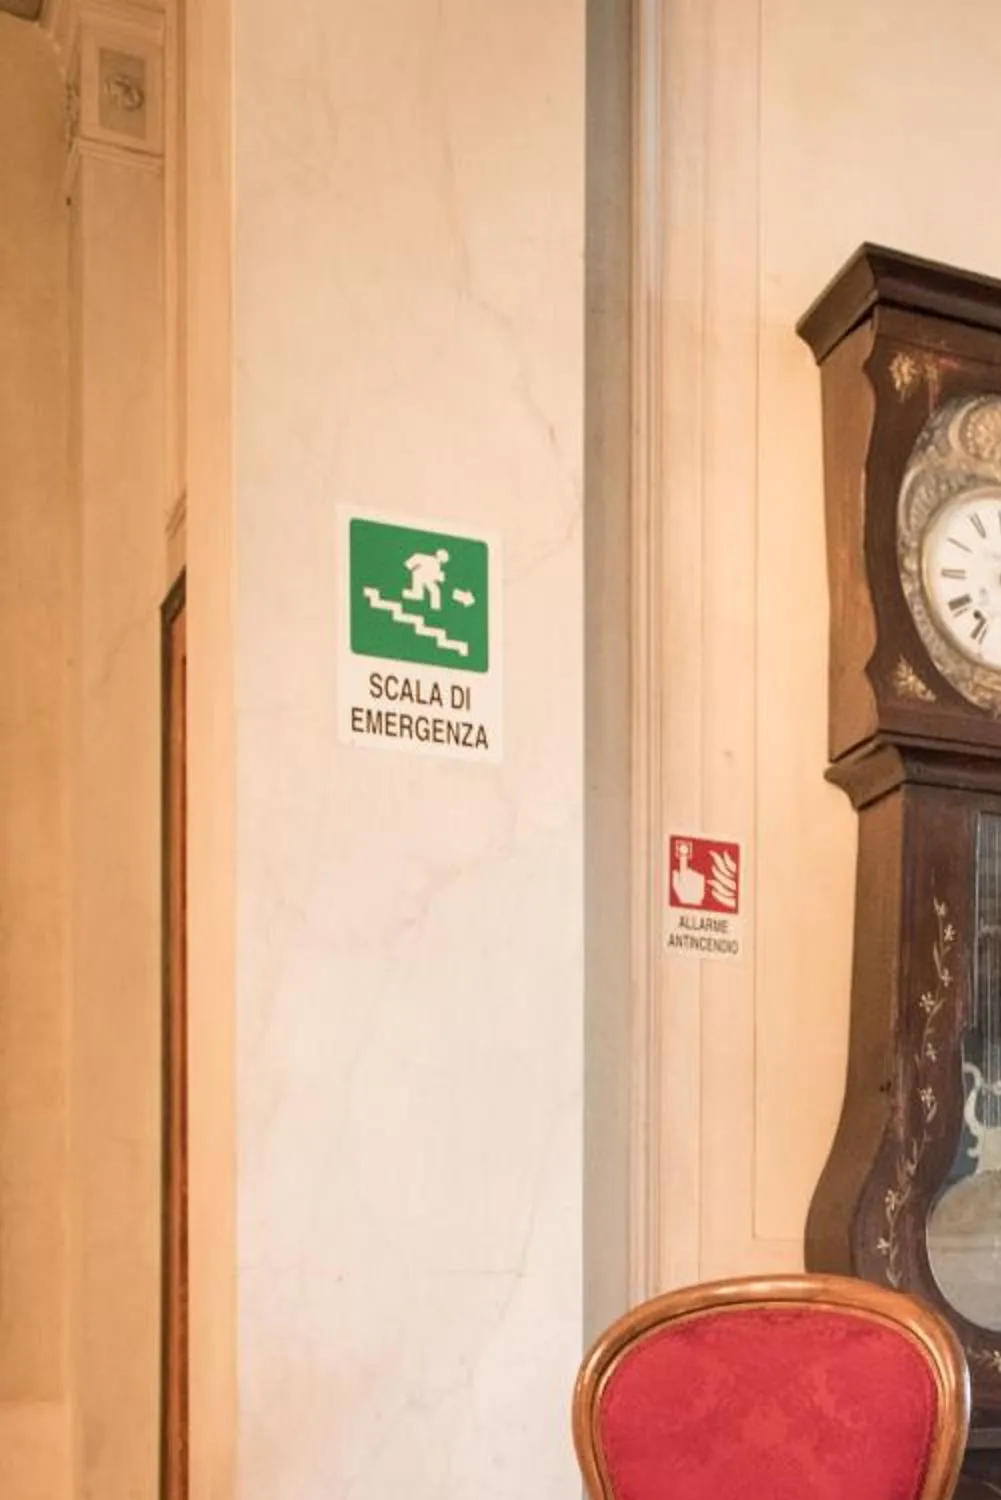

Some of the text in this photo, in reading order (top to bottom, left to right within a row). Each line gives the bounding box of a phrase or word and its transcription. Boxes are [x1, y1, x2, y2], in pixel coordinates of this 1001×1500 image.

[369, 672, 471, 711] SCALA DI
[351, 706, 489, 750] EMERGENZA
